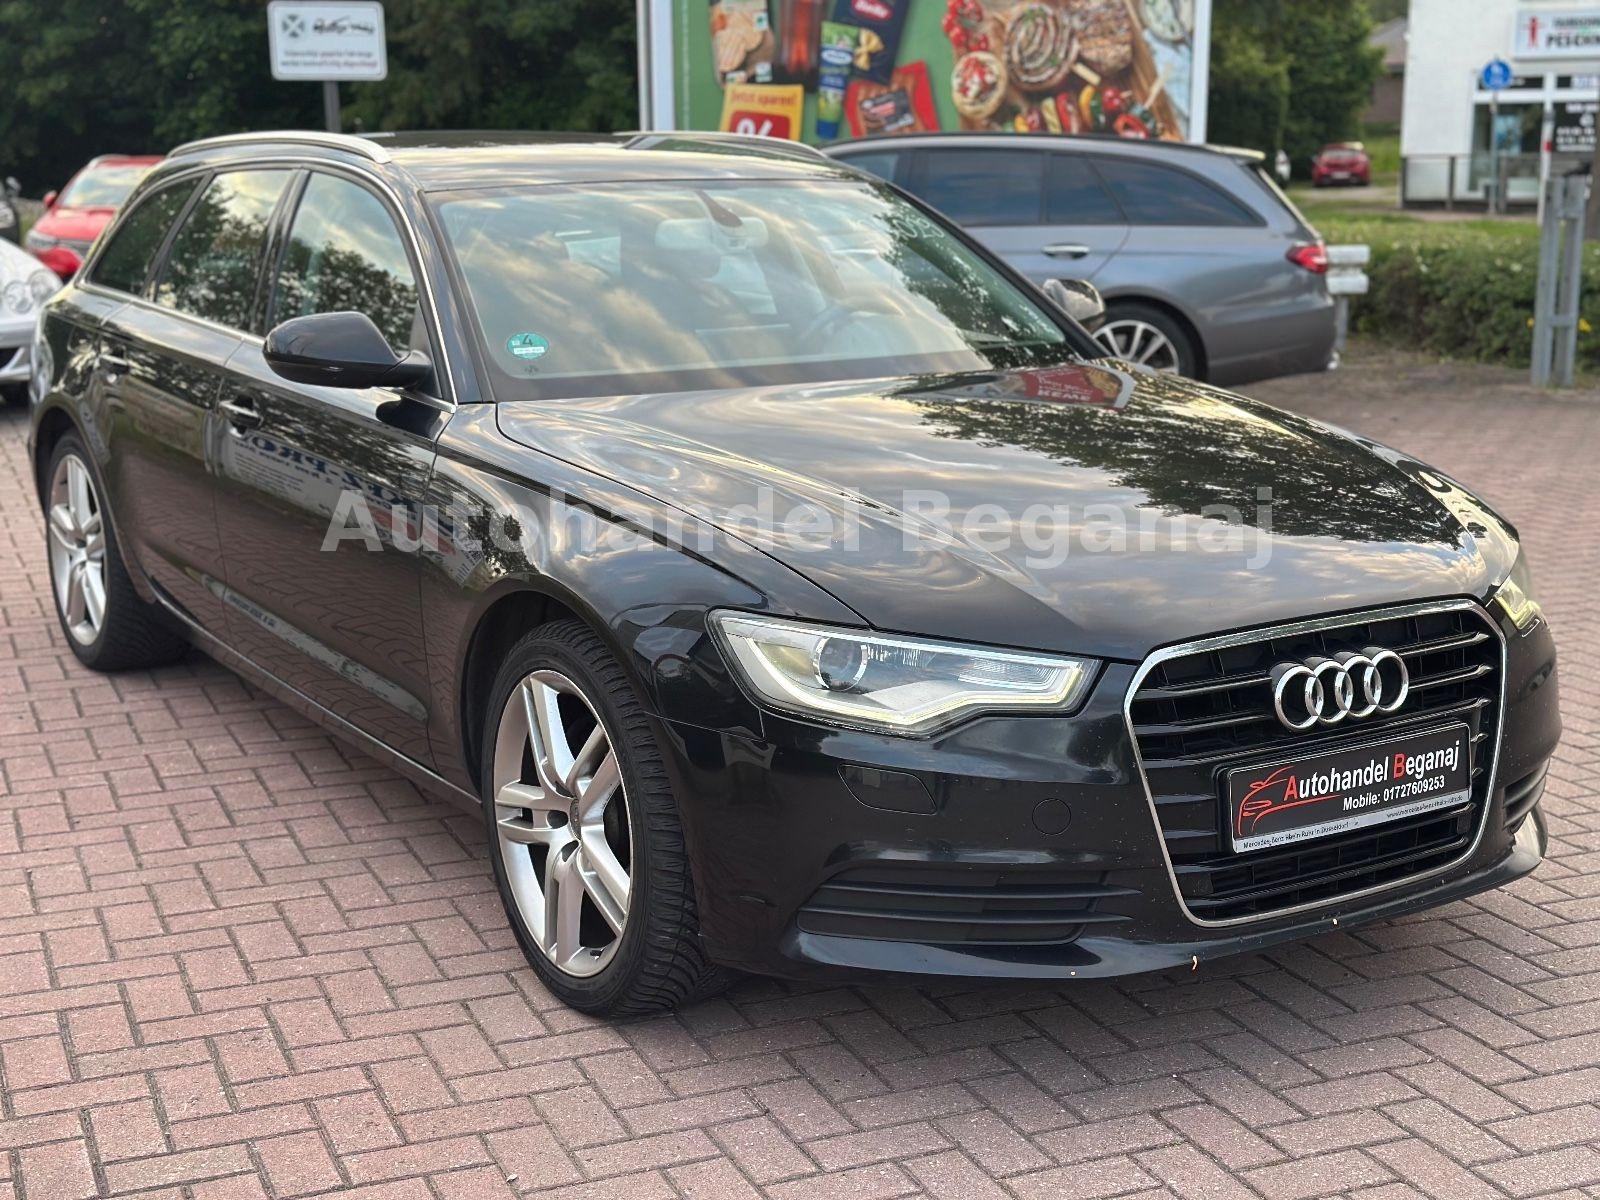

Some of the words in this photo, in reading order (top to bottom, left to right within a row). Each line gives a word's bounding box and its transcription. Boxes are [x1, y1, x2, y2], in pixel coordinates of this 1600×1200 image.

[1283, 756, 1389, 801] Autohandel
[1393, 740, 1460, 779] Beganaj
[1343, 792, 1381, 811] Mobile:
[1383, 775, 1445, 802] 01727609253
